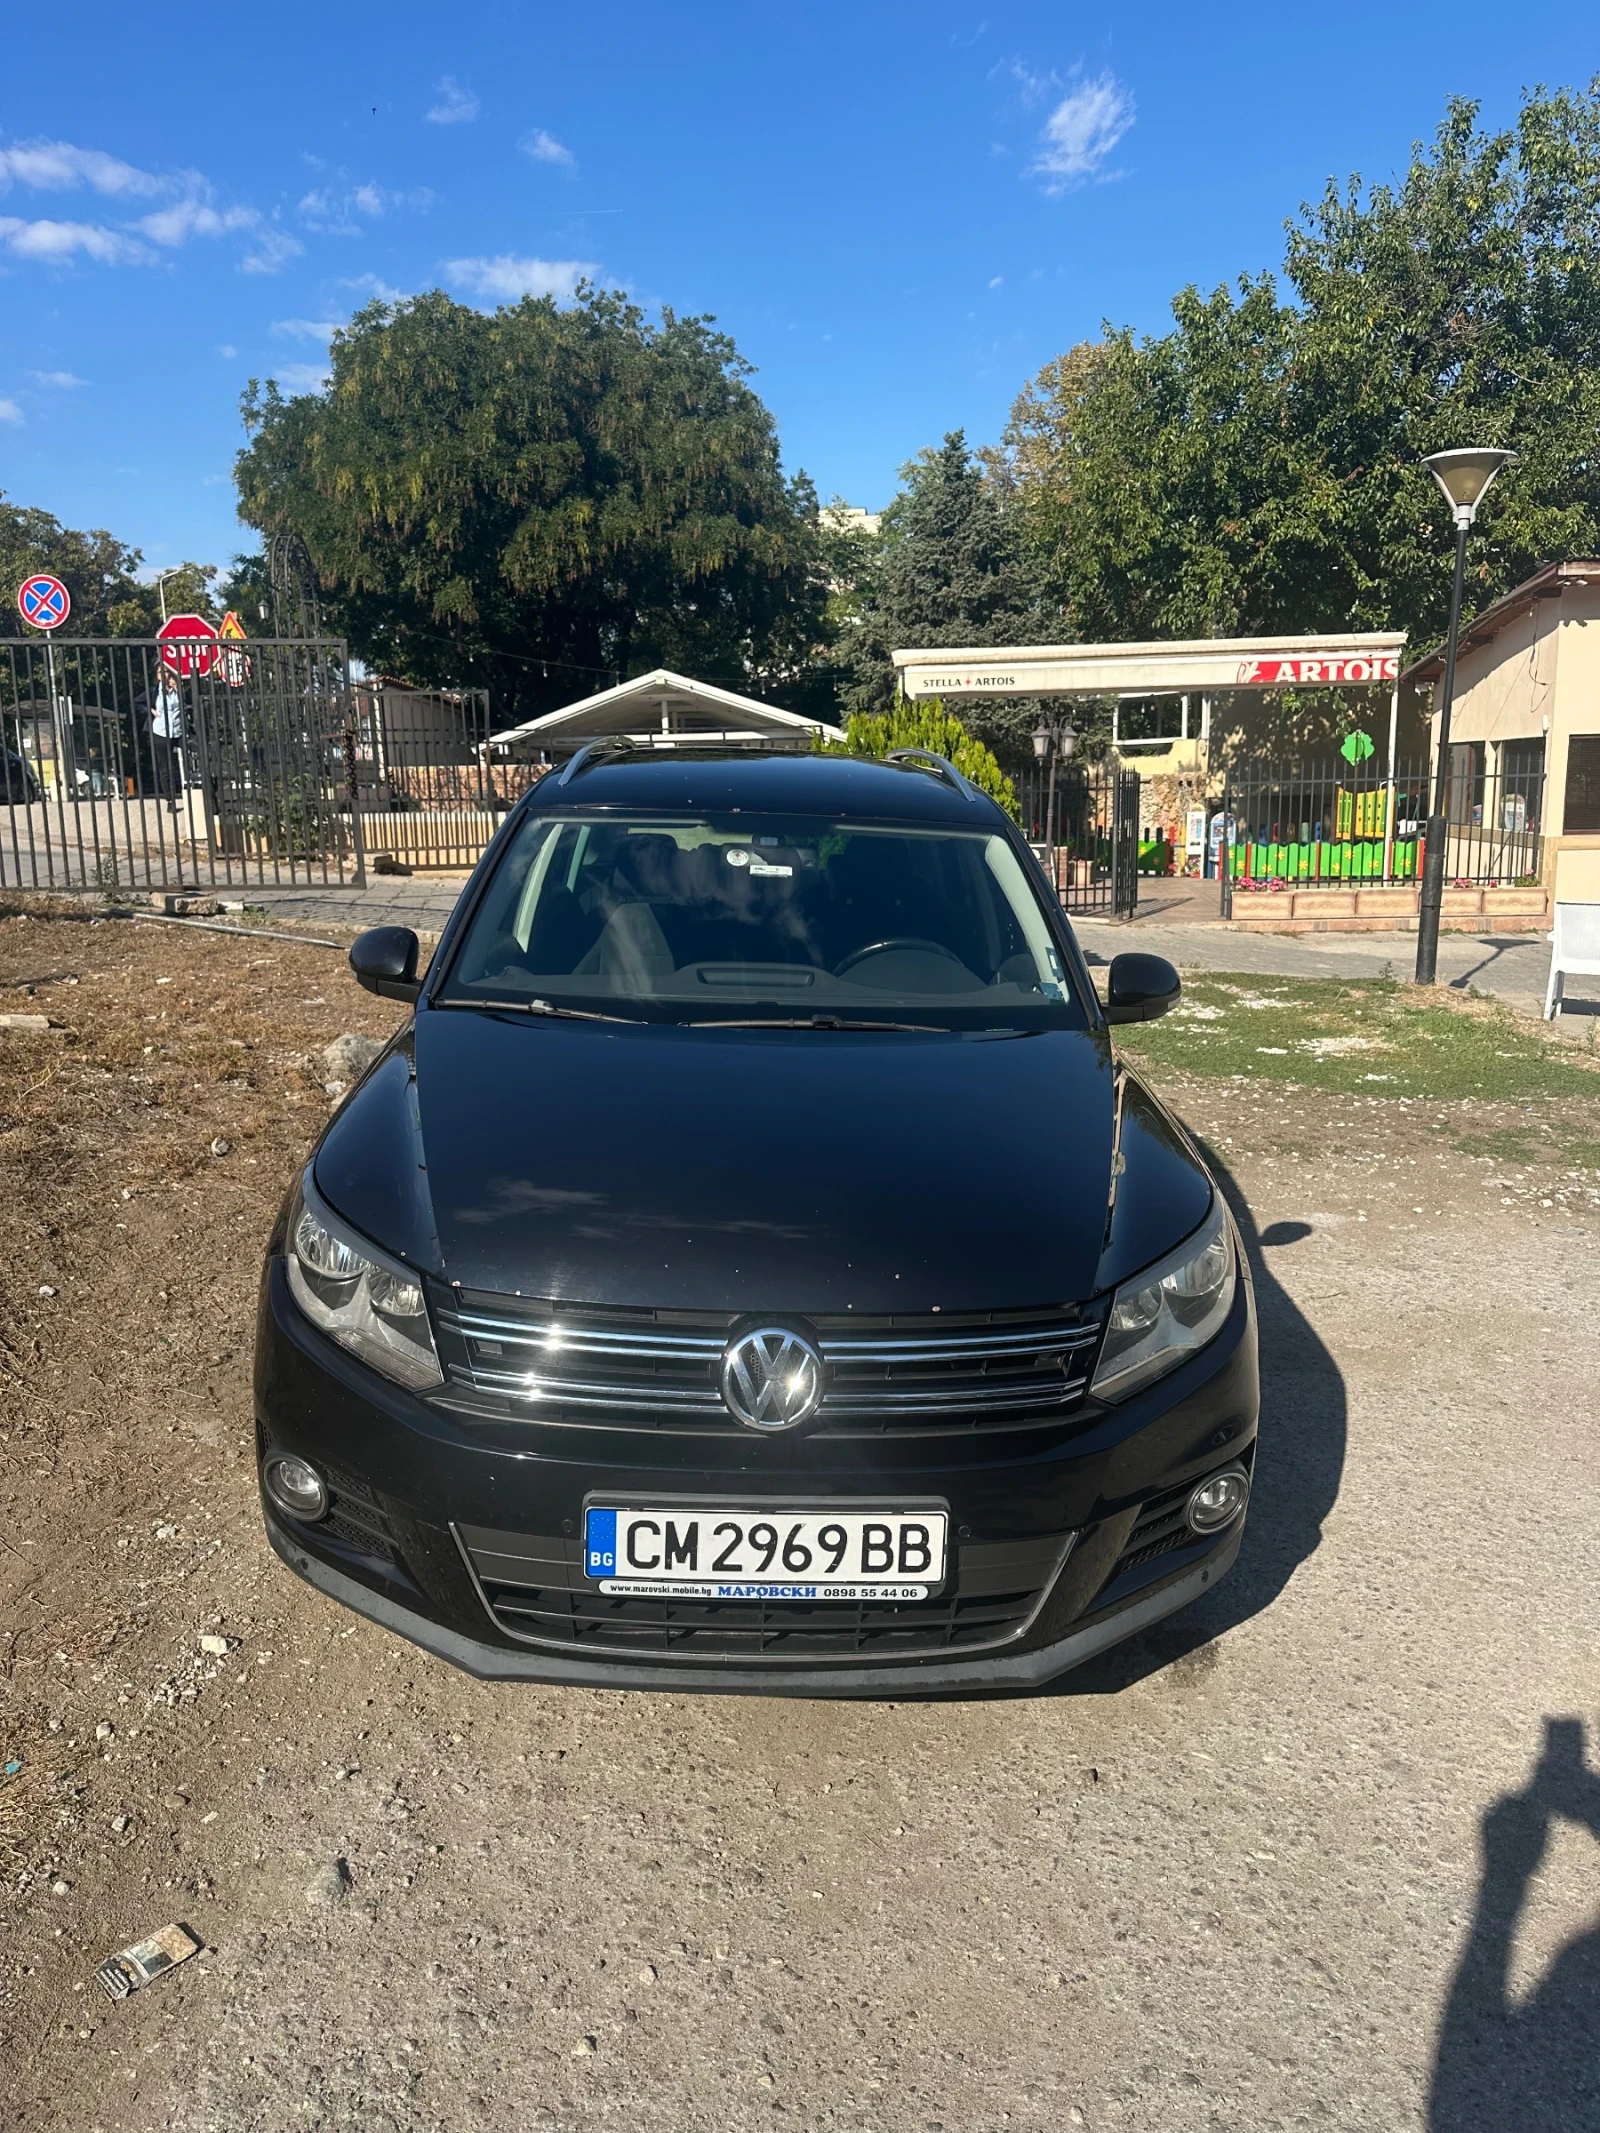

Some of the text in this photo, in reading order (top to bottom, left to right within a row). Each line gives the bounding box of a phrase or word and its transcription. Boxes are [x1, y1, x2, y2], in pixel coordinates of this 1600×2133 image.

[166, 635, 211, 658] STOP
[1274, 658, 1398, 683] ARTOIS
[923, 677, 1015, 687] STELLA ARTOIS
[626, 1520, 932, 1574] CM 2969 BB
[590, 1552, 613, 1567] BG
[610, 1583, 918, 1599] www.marovski.mobile.bg МАРОВСКИ 0898 55 44 06
